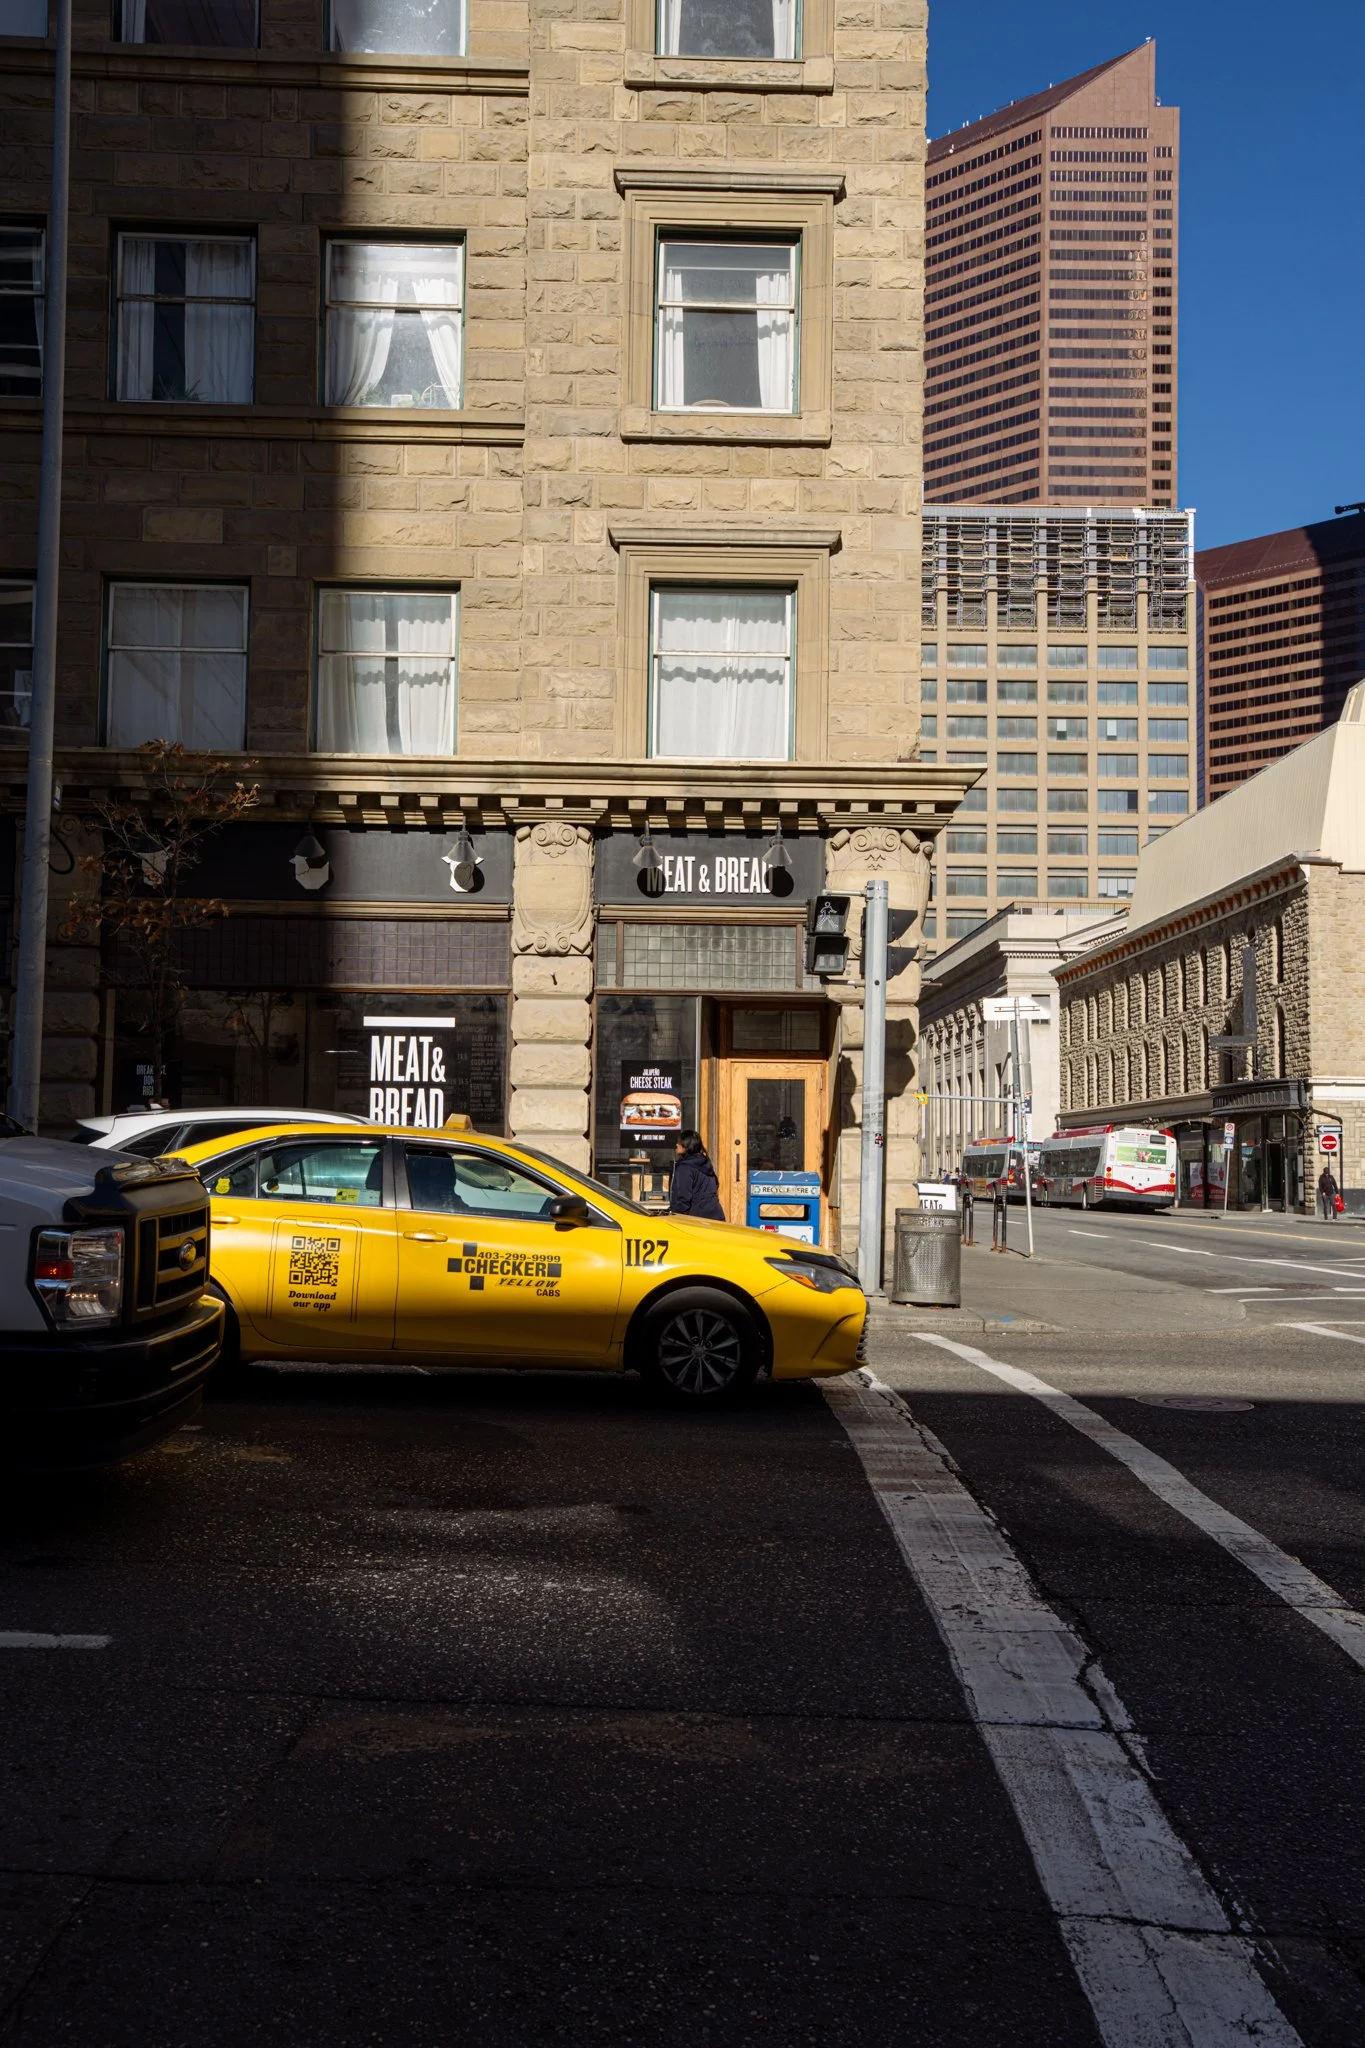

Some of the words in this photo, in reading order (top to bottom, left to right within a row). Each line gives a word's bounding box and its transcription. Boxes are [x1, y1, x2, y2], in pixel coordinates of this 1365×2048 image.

[646, 856, 696, 892] MEAT
[698, 864, 710, 893] &
[715, 856, 774, 893] BREAD
[370, 1035, 446, 1082] MEAT&
[630, 1076, 652, 1089] CHEESE
[653, 1076, 672, 1089] STEAK
[369, 1087, 444, 1128] BREAD
[478, 1251, 561, 1263] 403-299-9999
[625, 1238, 669, 1267] 1127
[464, 1258, 547, 1278] CHECKER
[497, 1278, 559, 1288] YELLOW
[288, 1290, 337, 1300] Download
[536, 1288, 561, 1297] CABS
[313, 1302, 331, 1312] app
